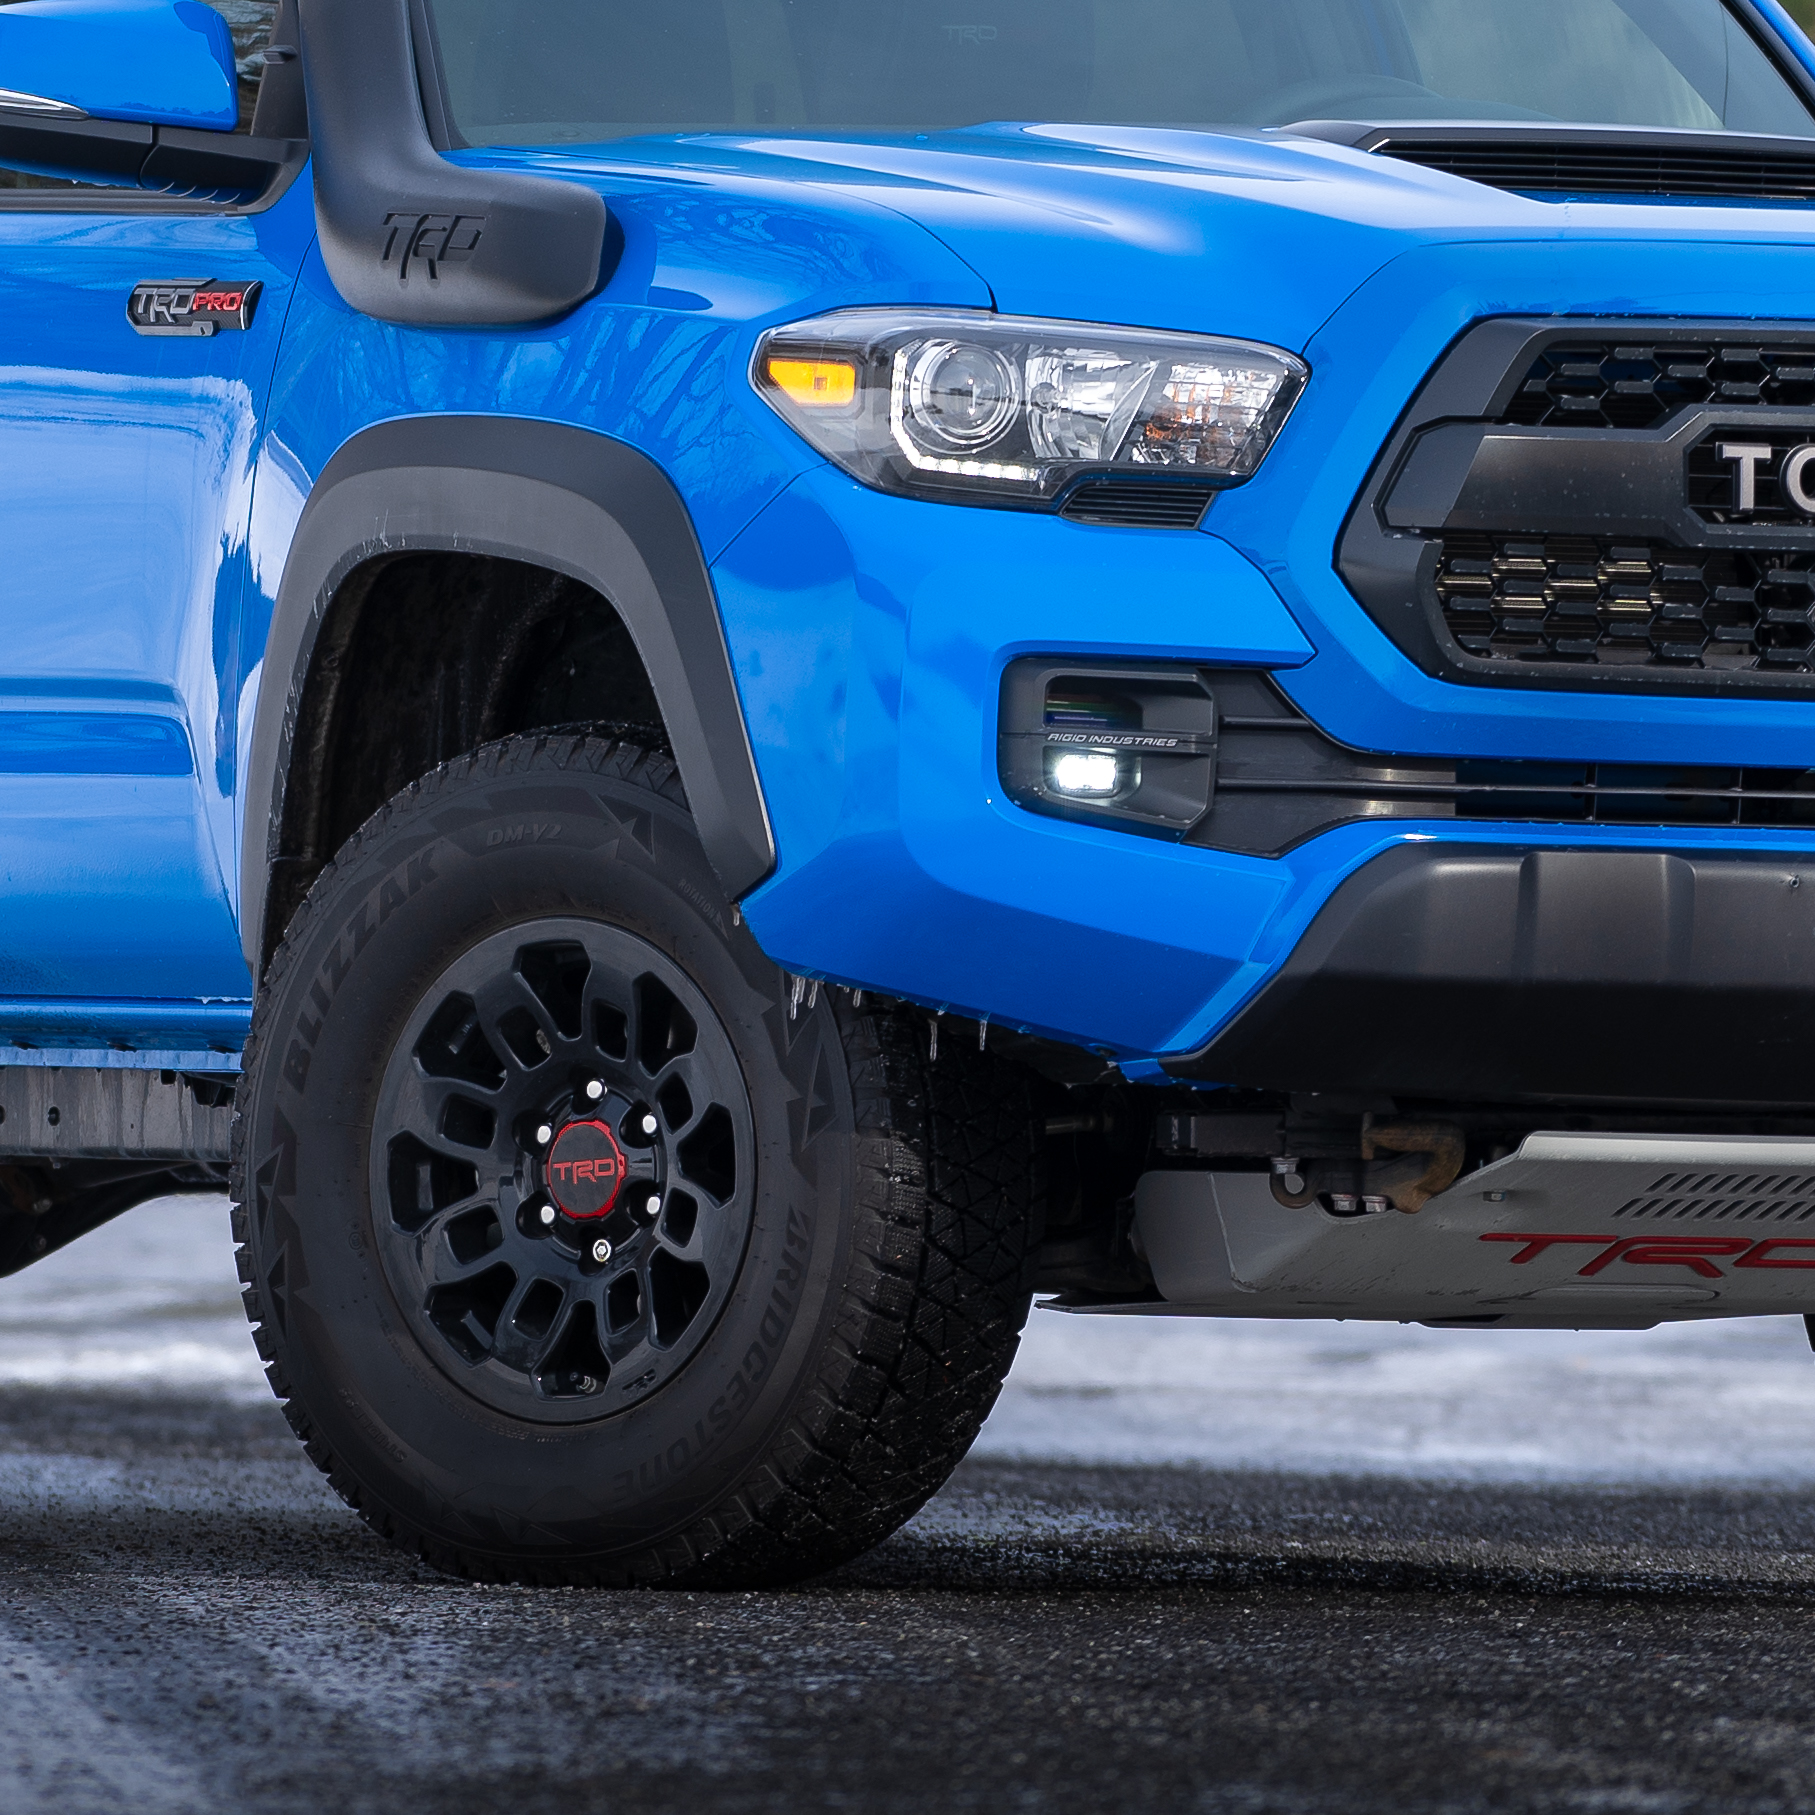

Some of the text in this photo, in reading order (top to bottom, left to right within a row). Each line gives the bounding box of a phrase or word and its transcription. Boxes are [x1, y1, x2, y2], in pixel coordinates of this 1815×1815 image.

[942, 25, 997, 44] TRD
[383, 212, 485, 280] TRD
[1047, 733, 1178, 747] RIGID INDUSTRIES
[486, 823, 562, 847] DM-V2
[677, 878, 718, 920] ROTATION
[283, 845, 440, 1095] BLIZZAK
[553, 1158, 615, 1184] TRD
[611, 1202, 813, 1503] BRIDGESTONE
